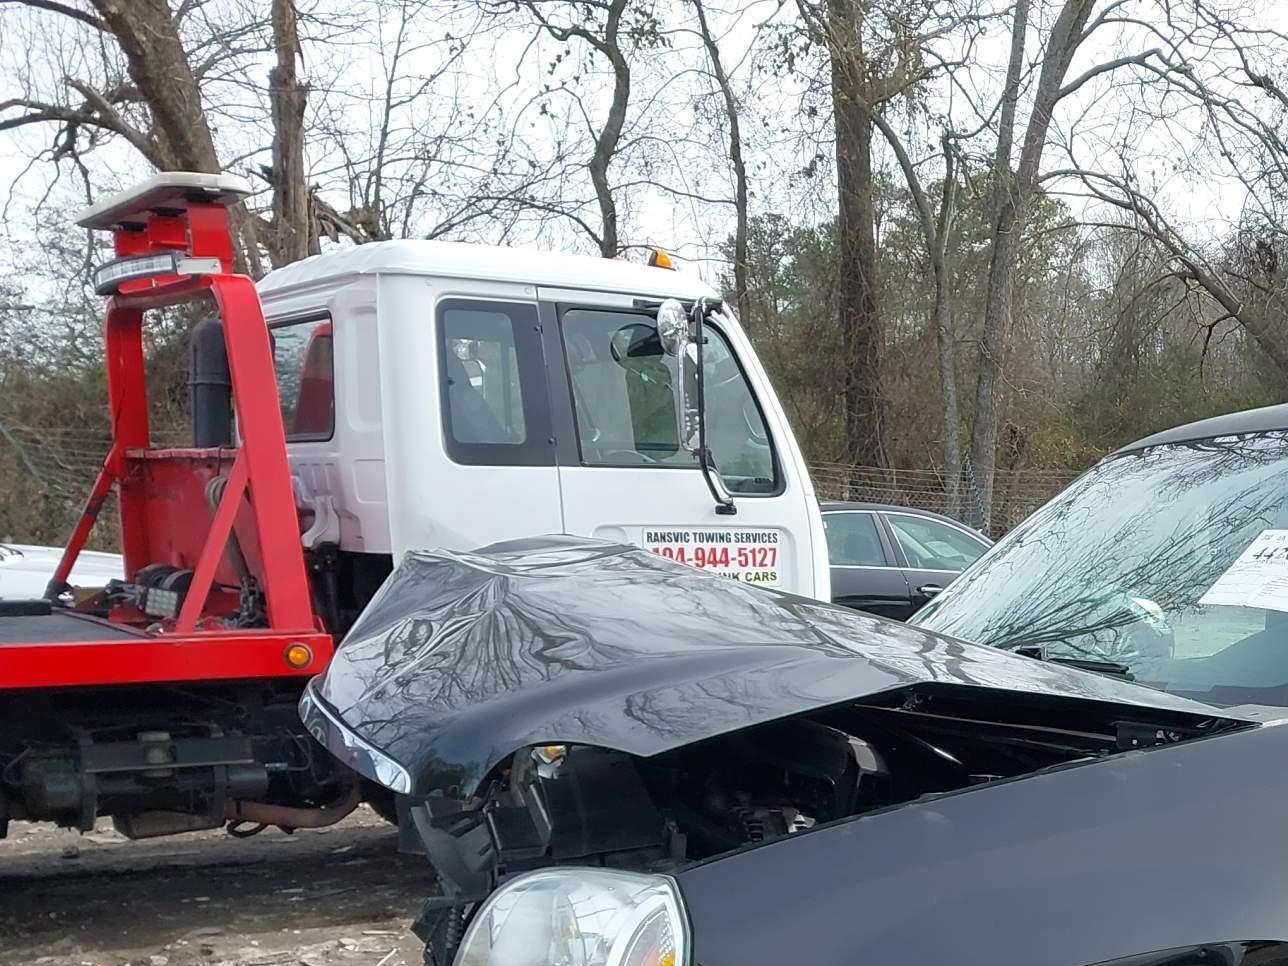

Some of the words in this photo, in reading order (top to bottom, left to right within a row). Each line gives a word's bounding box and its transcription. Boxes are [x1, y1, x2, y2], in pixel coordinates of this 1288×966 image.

[646, 531, 690, 544] RANSVIC
[692, 532, 732, 544] TOWING
[734, 532, 778, 544] SERVICES
[744, 571, 777, 582] CARS
